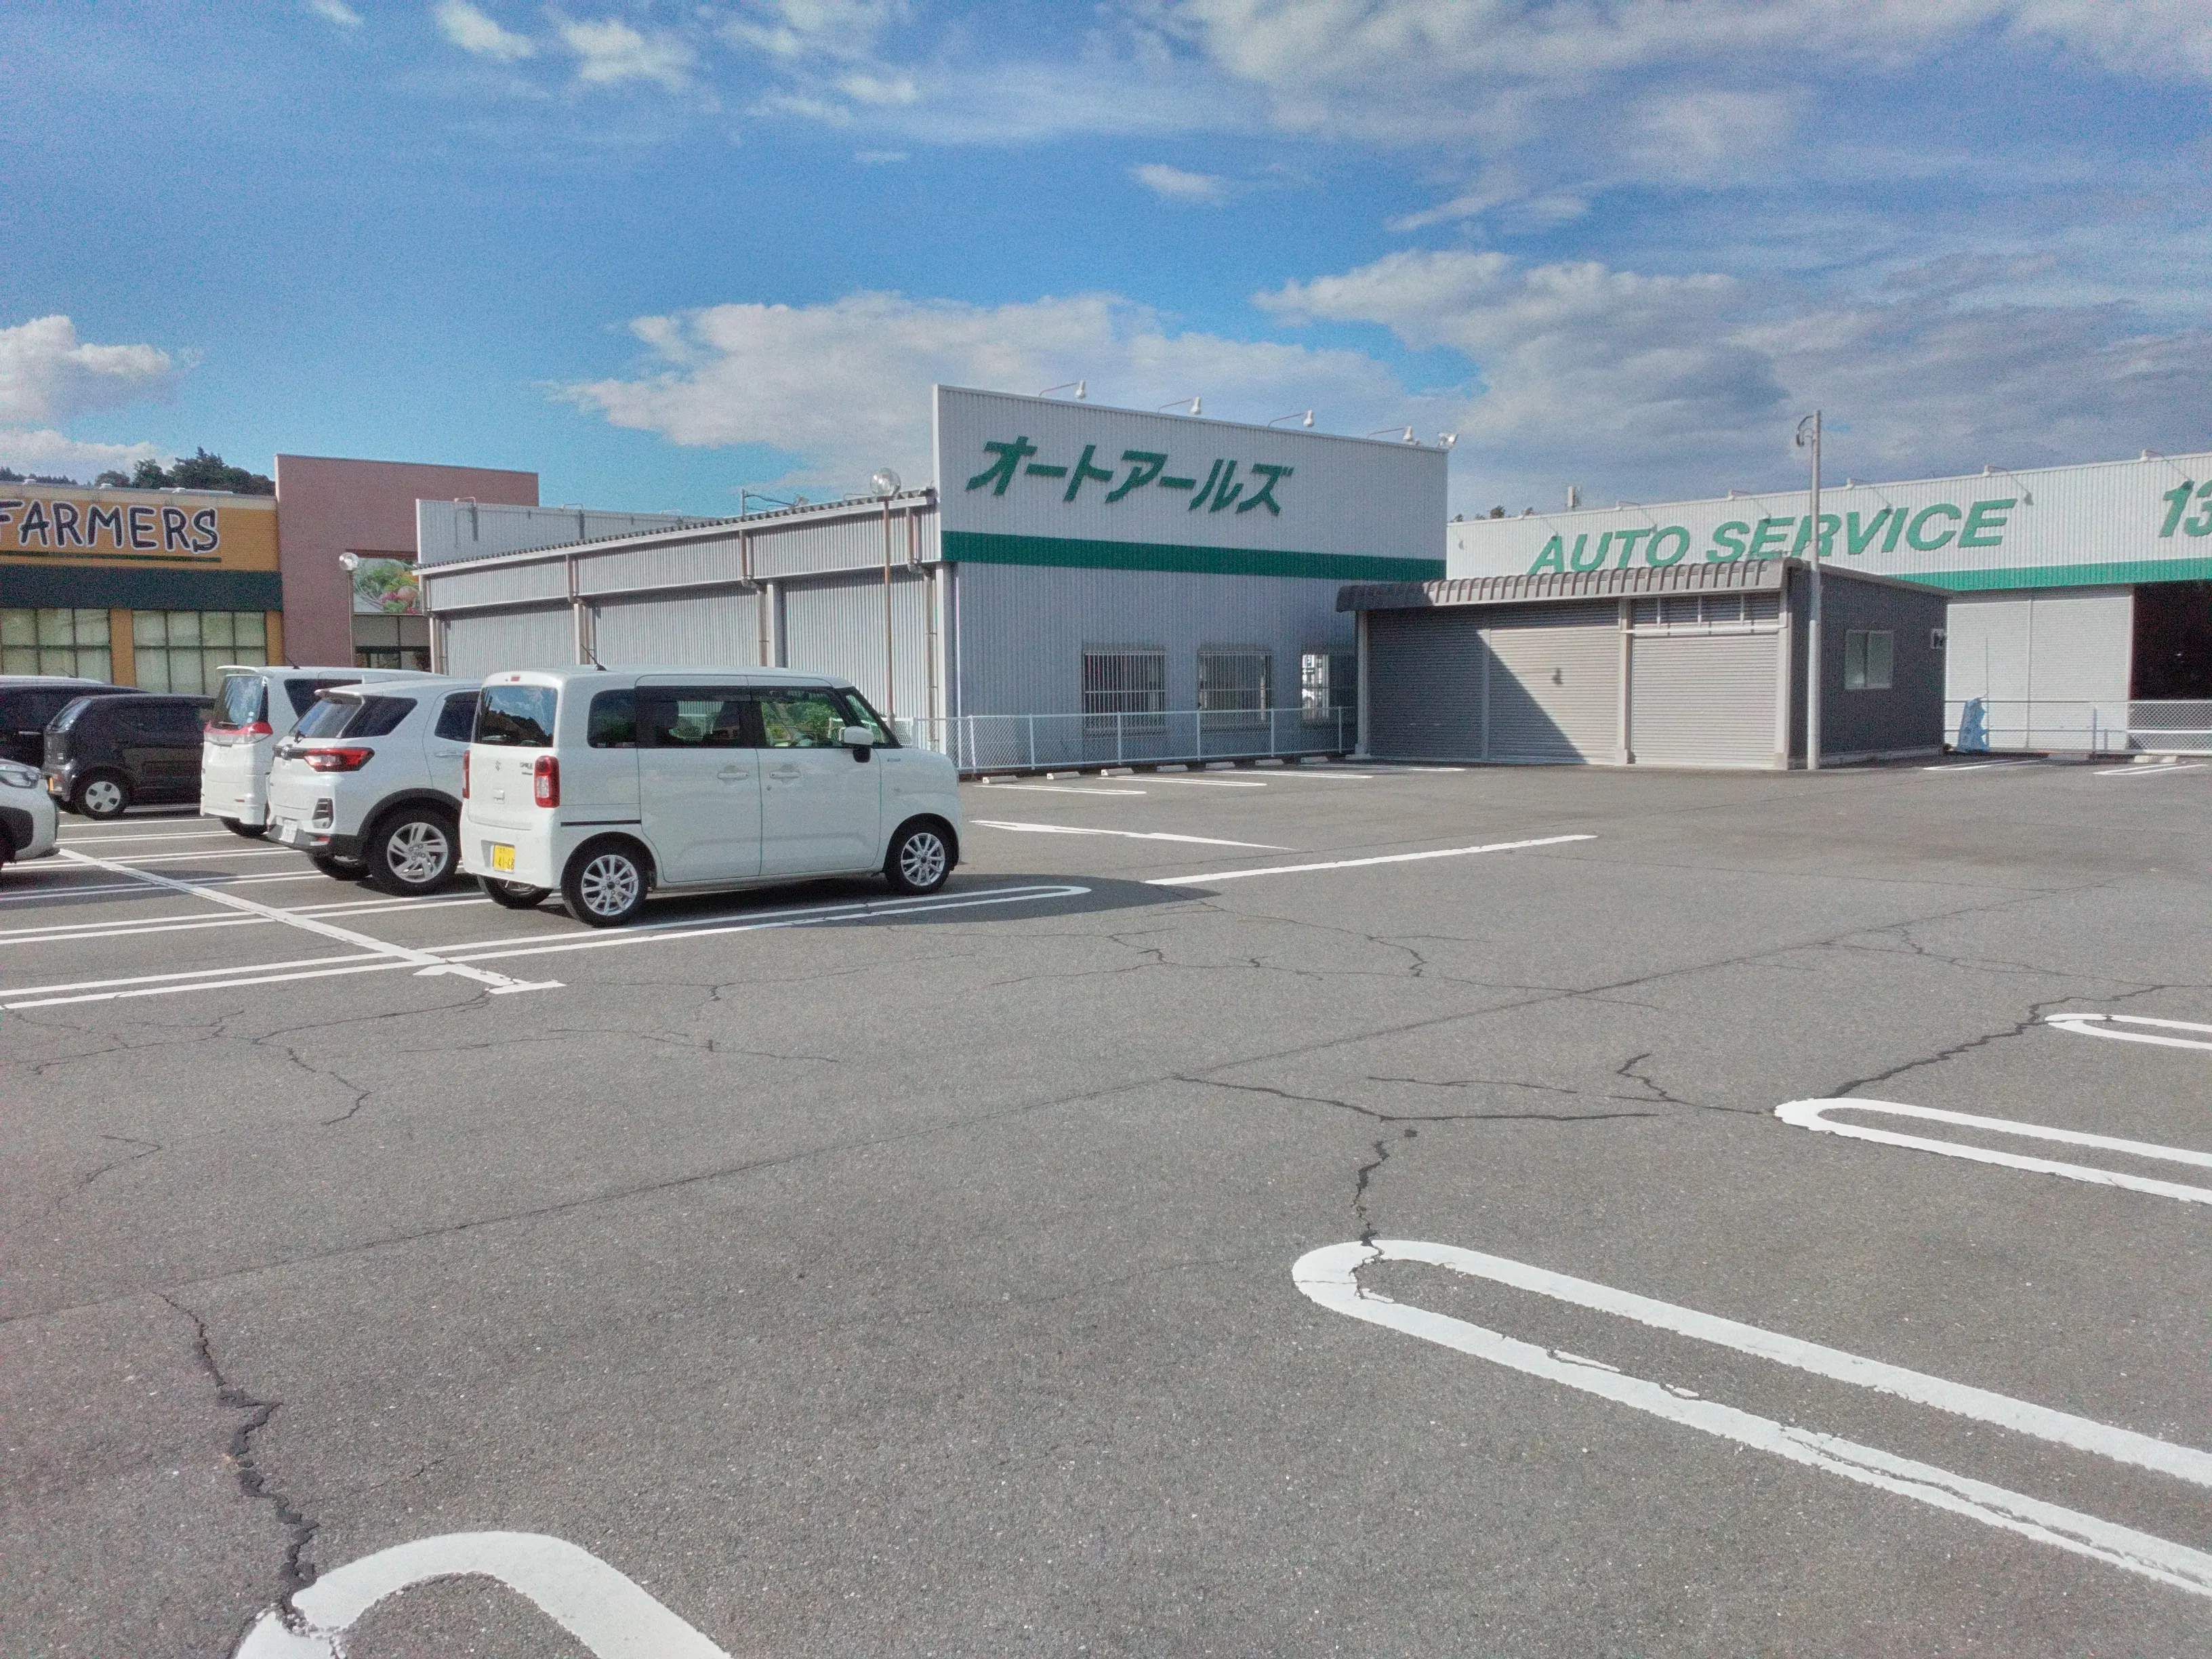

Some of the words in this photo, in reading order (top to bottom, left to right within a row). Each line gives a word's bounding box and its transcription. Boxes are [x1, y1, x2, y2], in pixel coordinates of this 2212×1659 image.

[966, 436, 1293, 516] オートアールズ
[1528, 525, 1690, 574] AUTO
[1706, 498, 2017, 563] SERVICE
